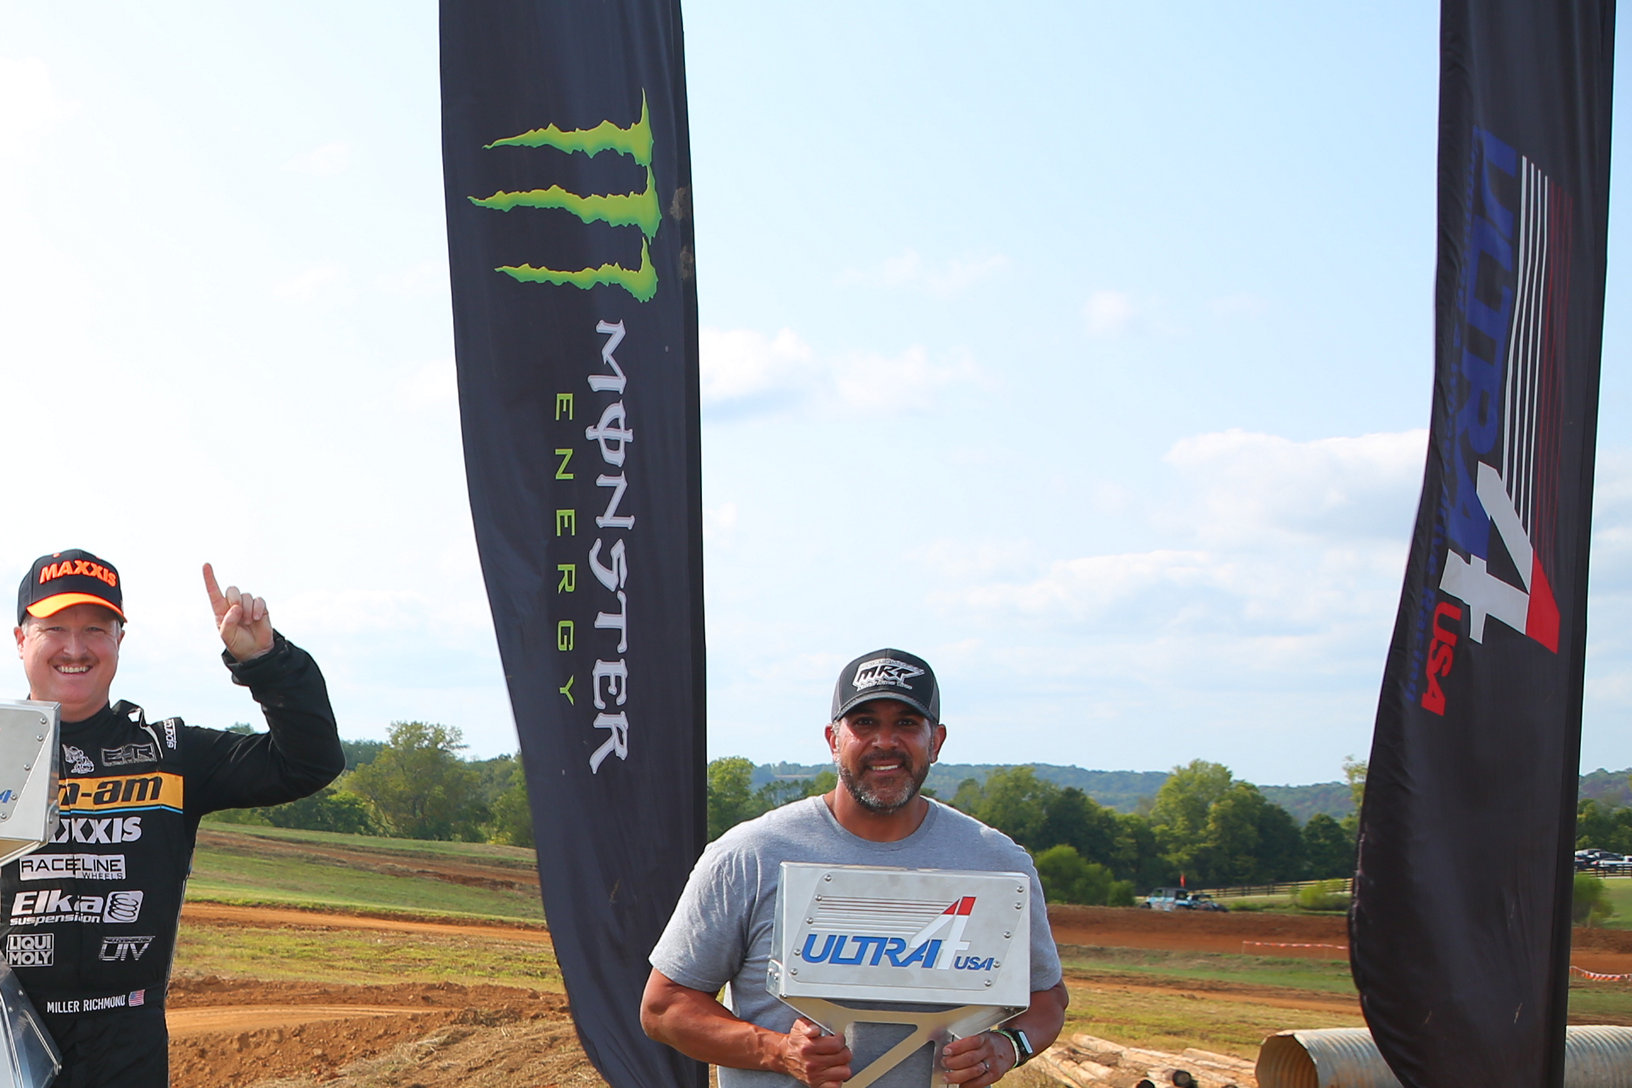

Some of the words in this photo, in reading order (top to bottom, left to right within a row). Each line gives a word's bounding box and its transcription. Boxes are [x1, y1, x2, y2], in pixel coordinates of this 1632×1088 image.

[554, 392, 577, 706] ENERGY
[585, 318, 636, 775] MONSTER
[39, 559, 117, 587] MAXXIS
[1420, 600, 1463, 717] USA
[21, 858, 122, 873] RACELINE
[82, 872, 124, 880] WHEELS
[11, 890, 104, 916] Elka
[9, 934, 52, 950] LIQUI
[9, 951, 52, 966] MOLY
[954, 955, 995, 971] USA
[46, 1001, 80, 1014] MILLER
[83, 994, 126, 1012] RICHMOND
